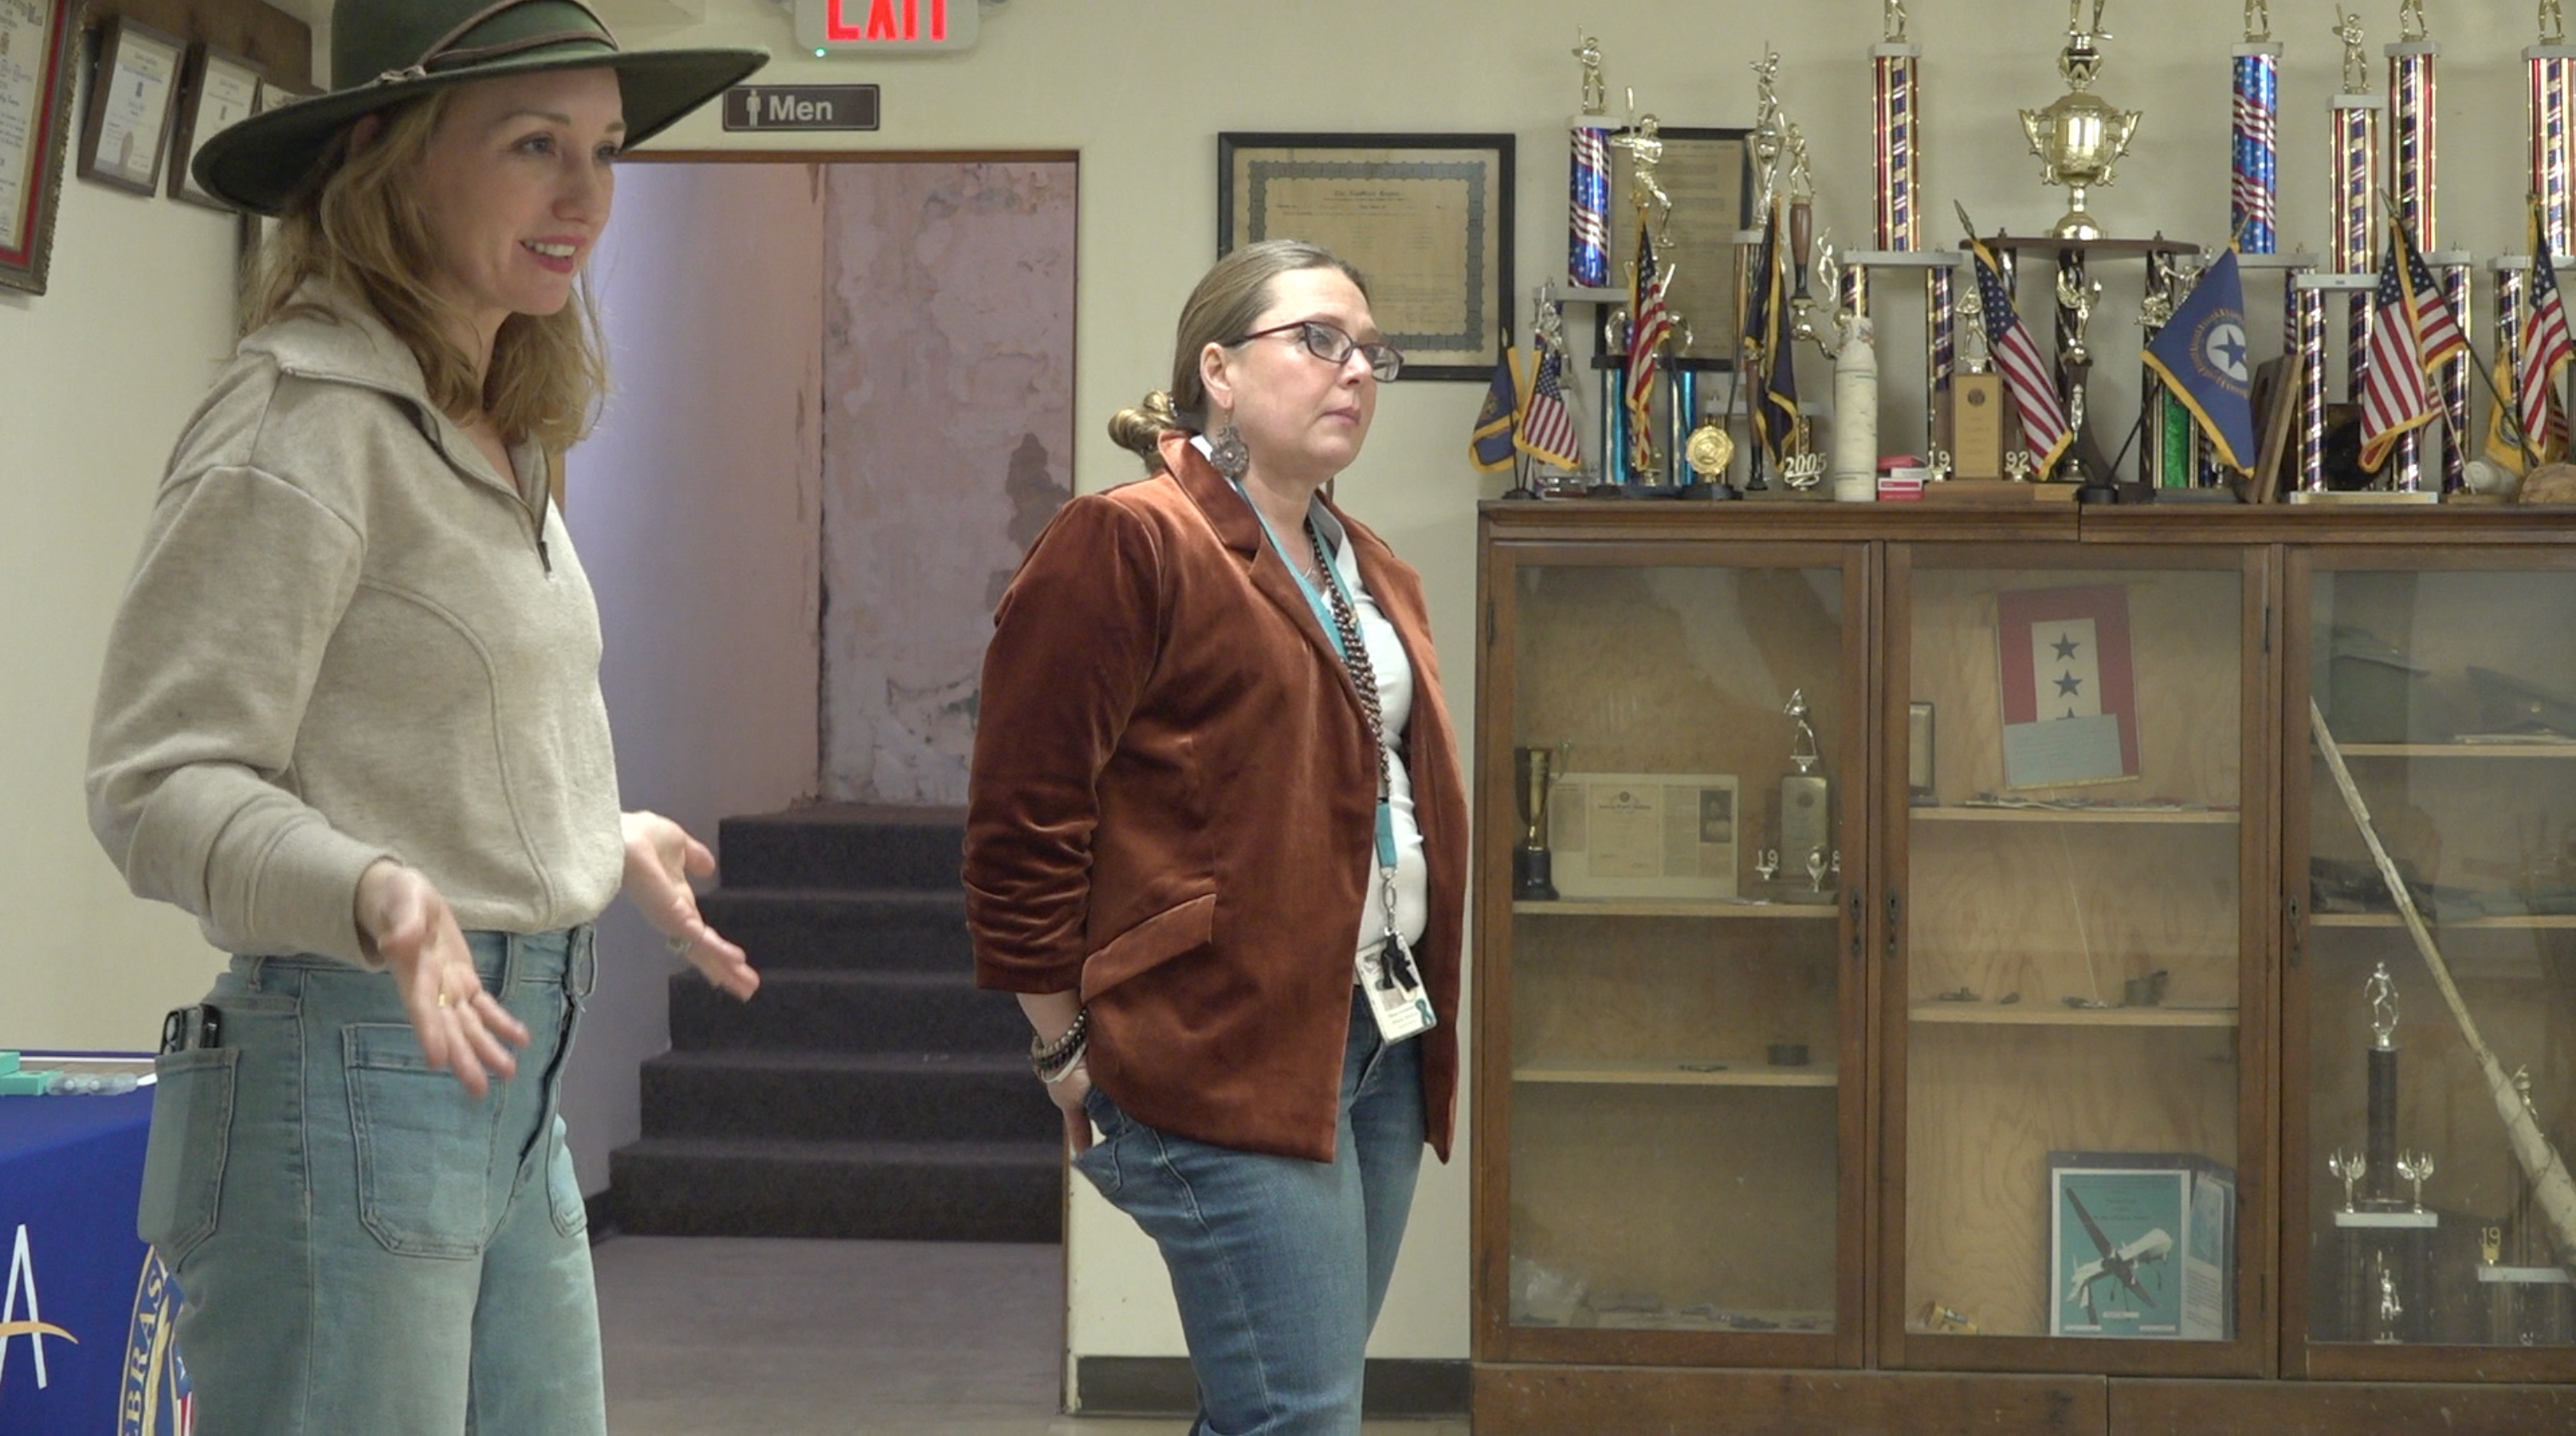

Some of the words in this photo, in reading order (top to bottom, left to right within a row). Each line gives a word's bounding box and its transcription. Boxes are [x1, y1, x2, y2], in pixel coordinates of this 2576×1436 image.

[769, 95, 832, 121] Men
[1784, 452, 1827, 475] 2005
[1928, 451, 1950, 468] 19
[2006, 451, 2029, 469] 92
[1757, 849, 1779, 868] 19
[2481, 1227, 2501, 1248] 19
[125, 1250, 169, 1436] BRAS
